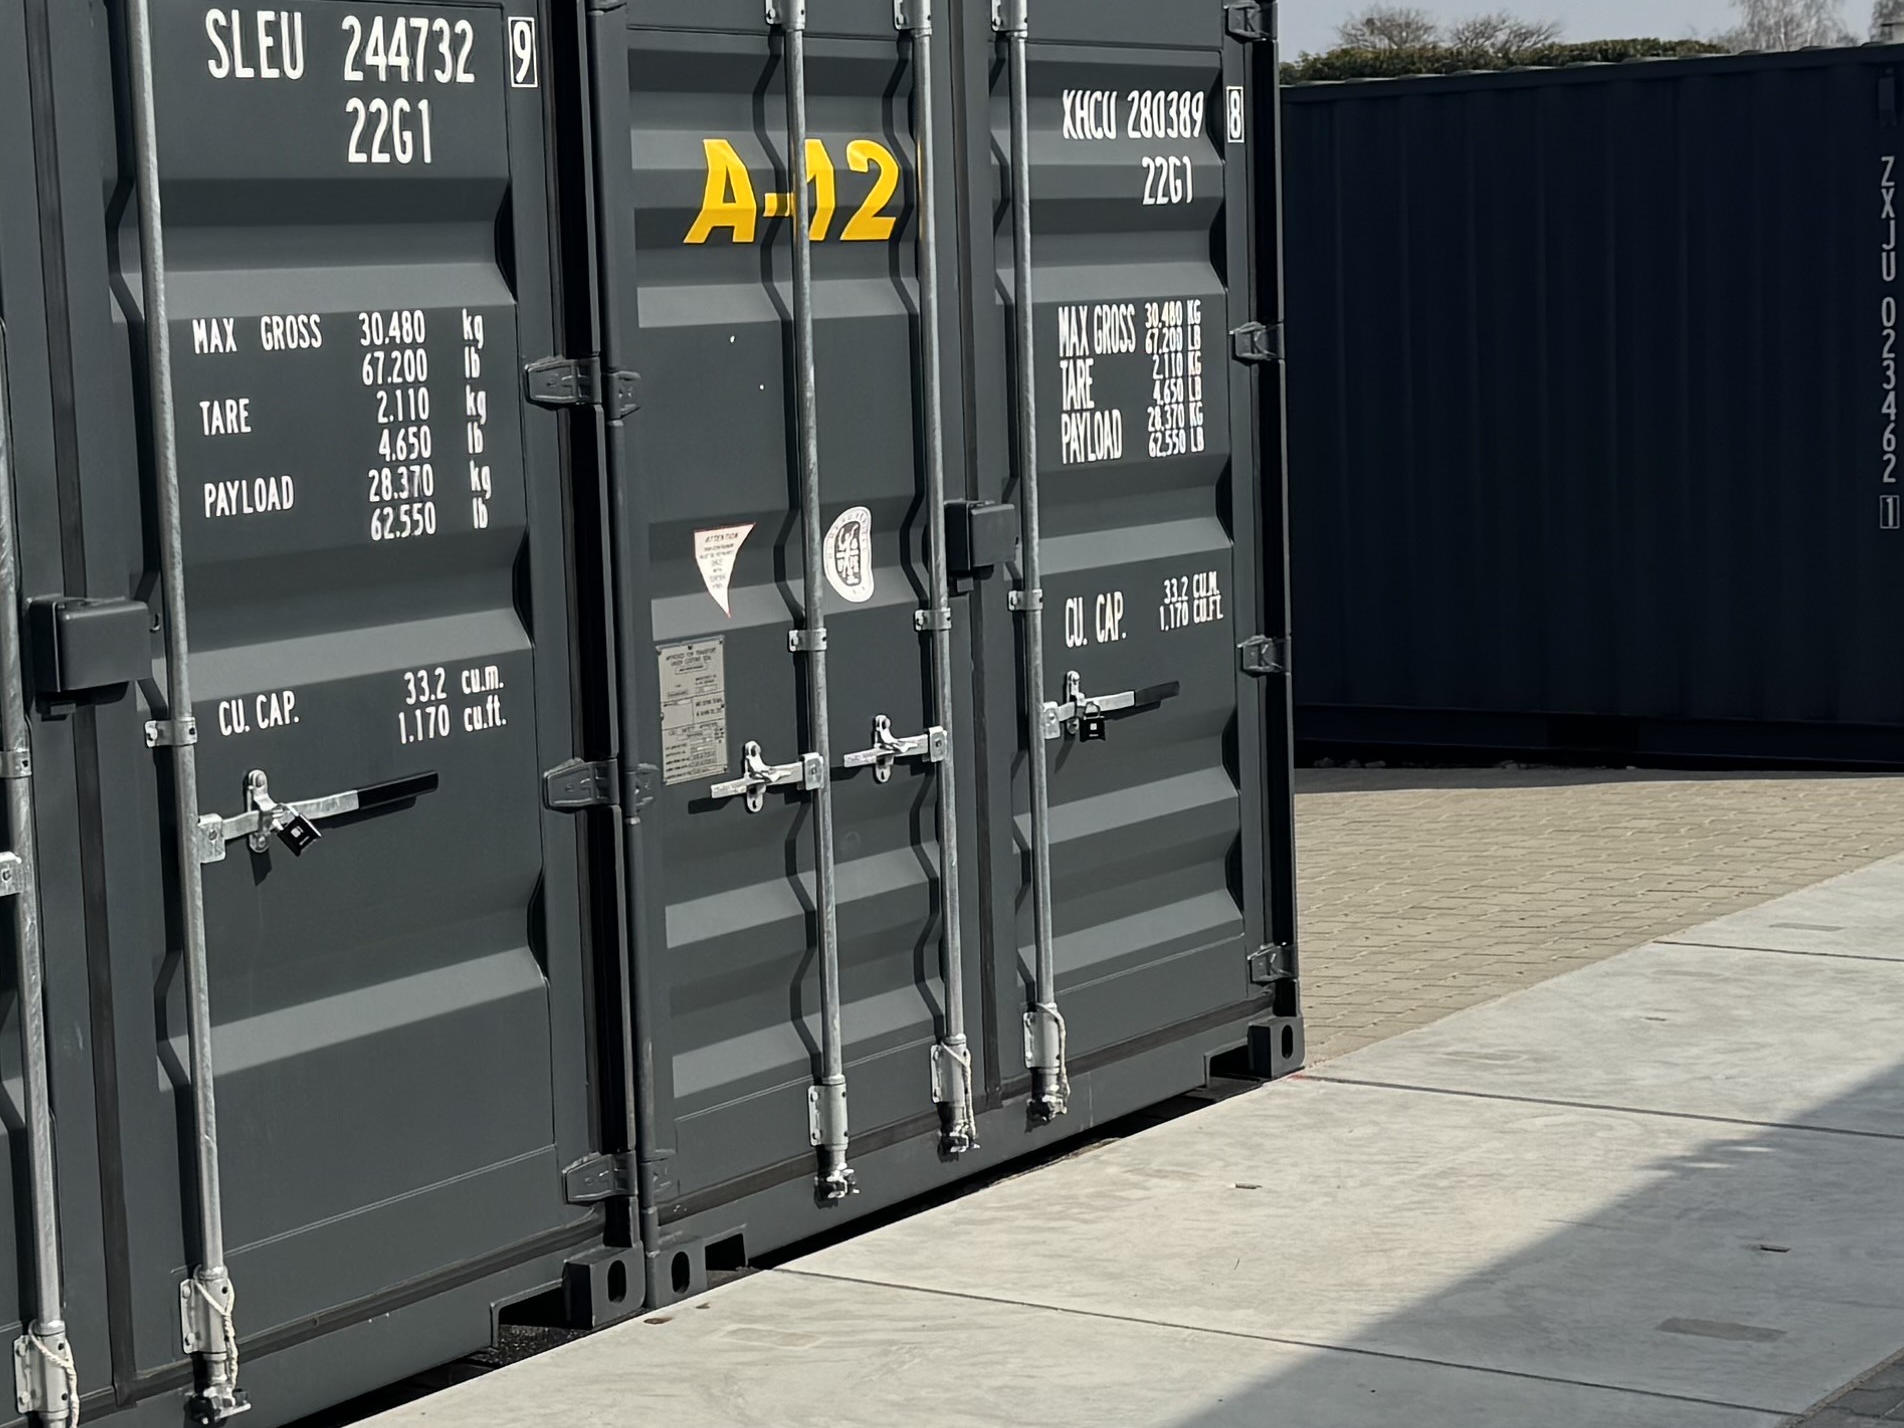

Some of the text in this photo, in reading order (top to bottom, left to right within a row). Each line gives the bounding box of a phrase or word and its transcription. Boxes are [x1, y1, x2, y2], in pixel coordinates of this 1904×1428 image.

[206, 9, 303, 79] SLEU
[342, 16, 474, 83] 244732
[346, 98, 431, 163] 22G1
[1062, 89, 1117, 140] XHCU
[1127, 89, 1204, 139] 280389
[683, 138, 901, 244] A-12
[1141, 155, 1193, 205] 22G1
[1880, 155, 1896, 282] ZXJU
[193, 318, 236, 353] MAX
[261, 314, 321, 350] GROSS
[463, 309, 483, 349] kg
[1058, 305, 1090, 358] MAX
[1093, 303, 1137, 355] GROSS
[1186, 299, 1202, 325] KG
[1187, 324, 1202, 351] LB
[465, 347, 479, 378] lb
[1059, 357, 1096, 411] TARE
[1188, 350, 1203, 377] KG
[200, 399, 251, 435] TARE
[466, 385, 486, 424] kg
[1188, 375, 1203, 402] LB
[1881, 296, 1897, 483] 023462
[468, 422, 483, 453] lb
[1061, 408, 1123, 464] PAYLOAD
[1189, 401, 1204, 427] KG
[1190, 426, 1205, 453] LB
[205, 476, 293, 517] PAYLOAD
[470, 461, 491, 499] kg
[473, 498, 487, 528] lb
